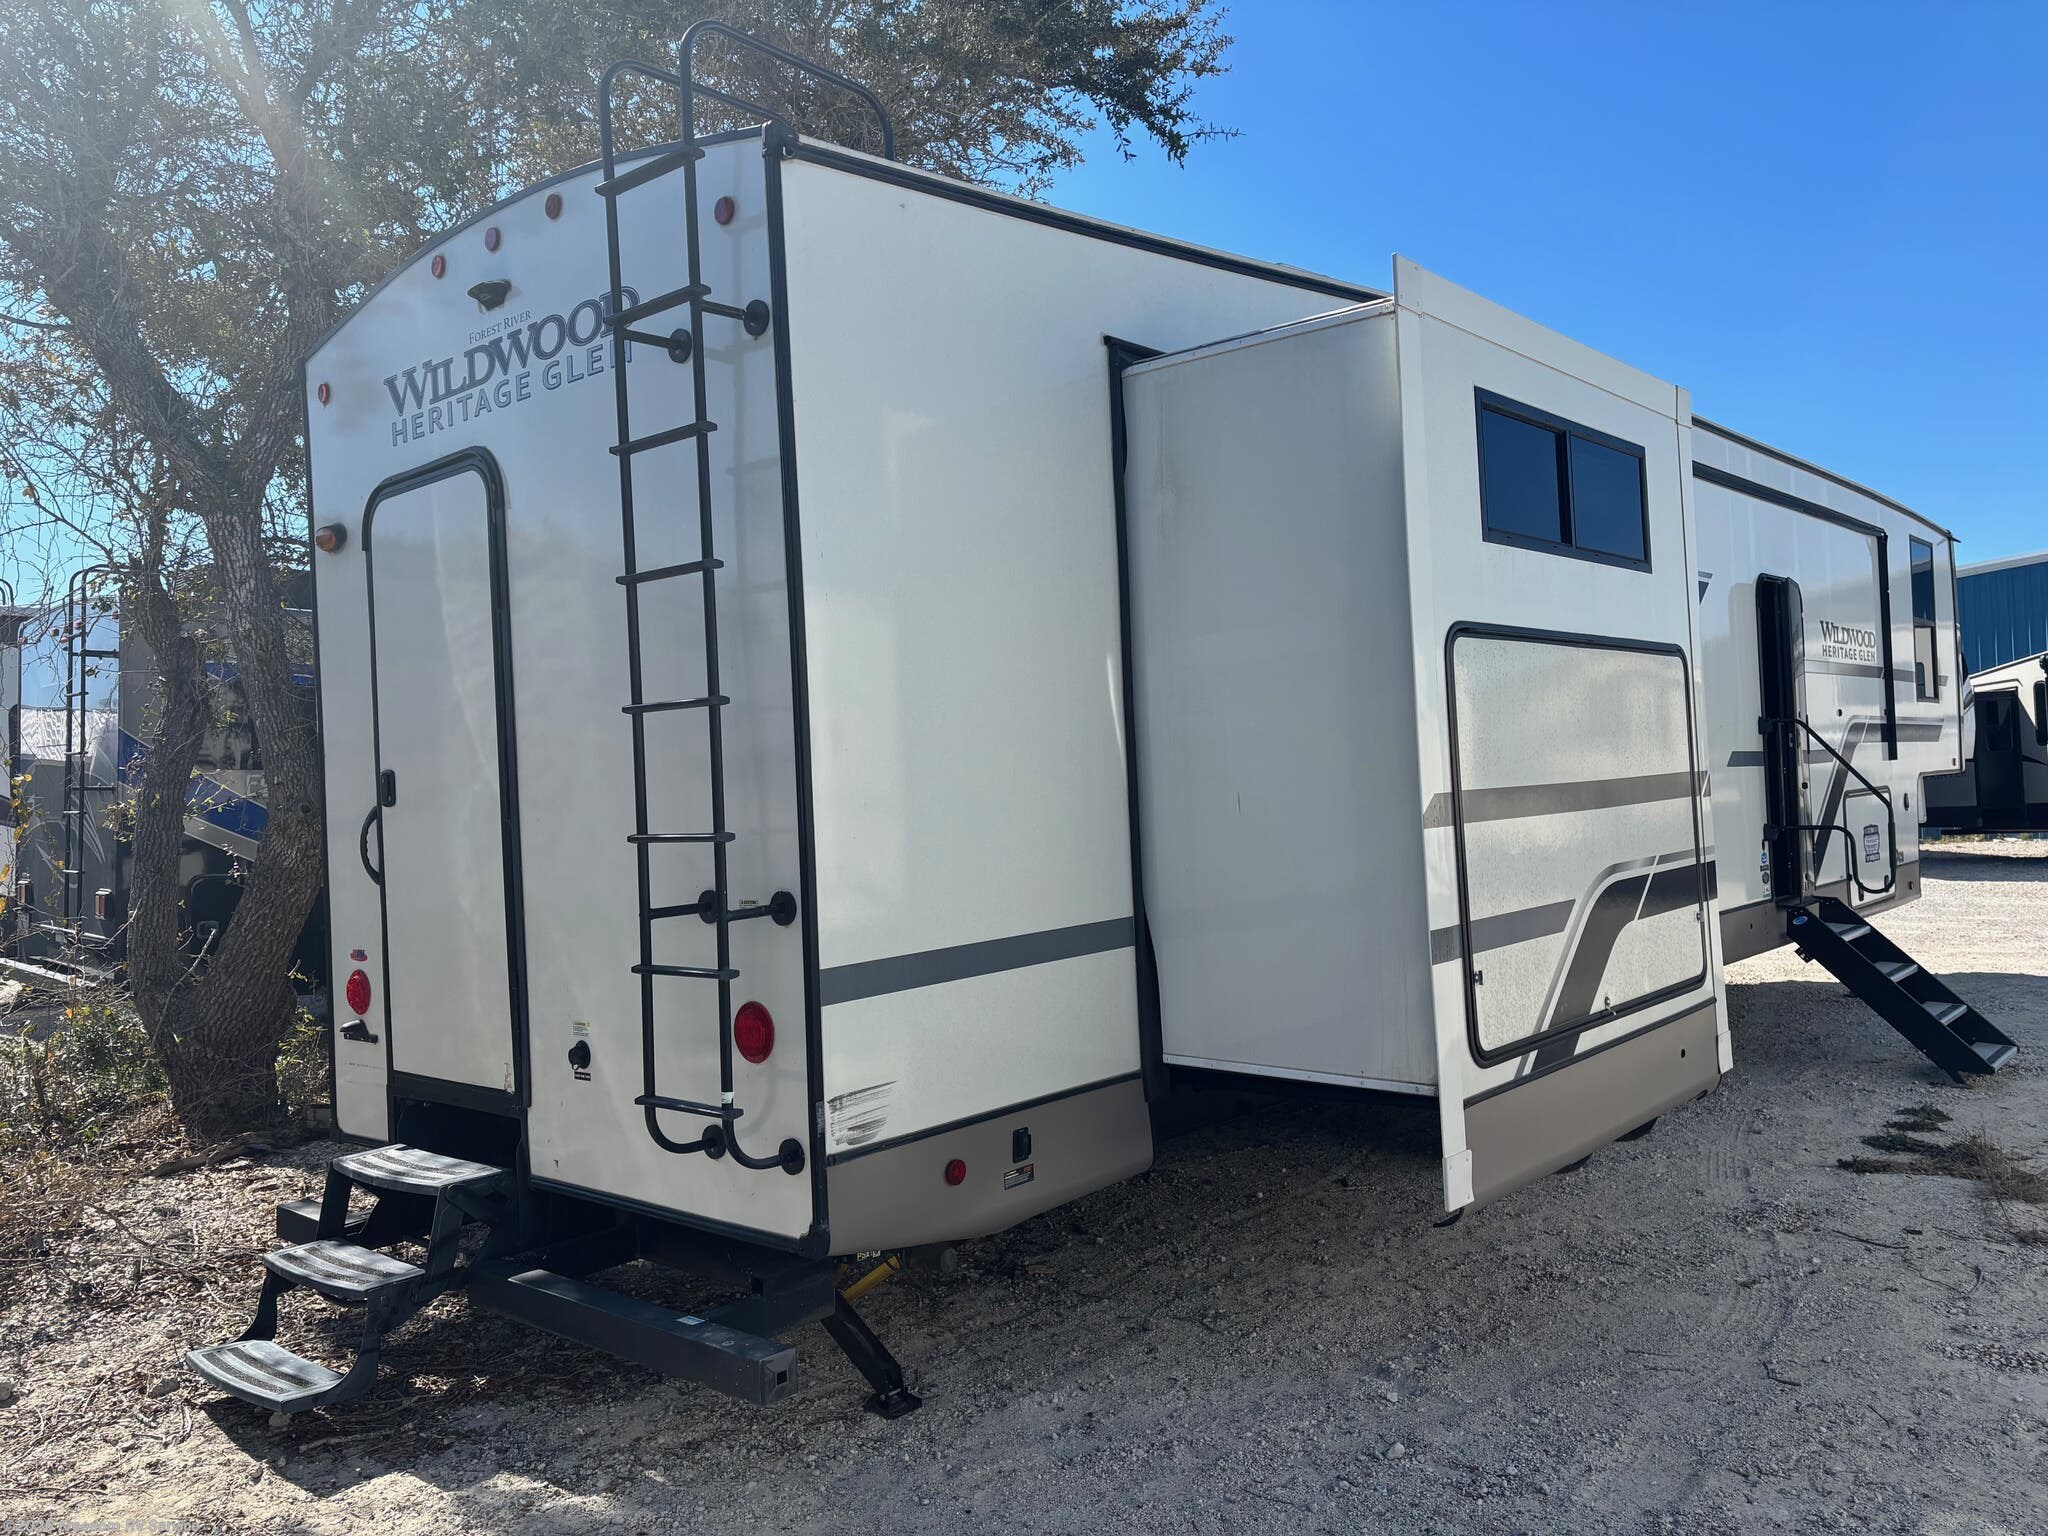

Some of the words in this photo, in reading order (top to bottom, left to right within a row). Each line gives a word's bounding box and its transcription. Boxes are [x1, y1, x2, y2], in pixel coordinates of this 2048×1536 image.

[469, 321, 502, 344] FOREST
[503, 310, 531, 329] RIVER
[384, 286, 640, 416] WILDWOOD
[391, 373, 532, 447] HERITAGE
[1819, 620, 1876, 648] WILDWOOD
[1822, 645, 1857, 660] HERITAGE
[1859, 649, 1876, 662] GLEN
